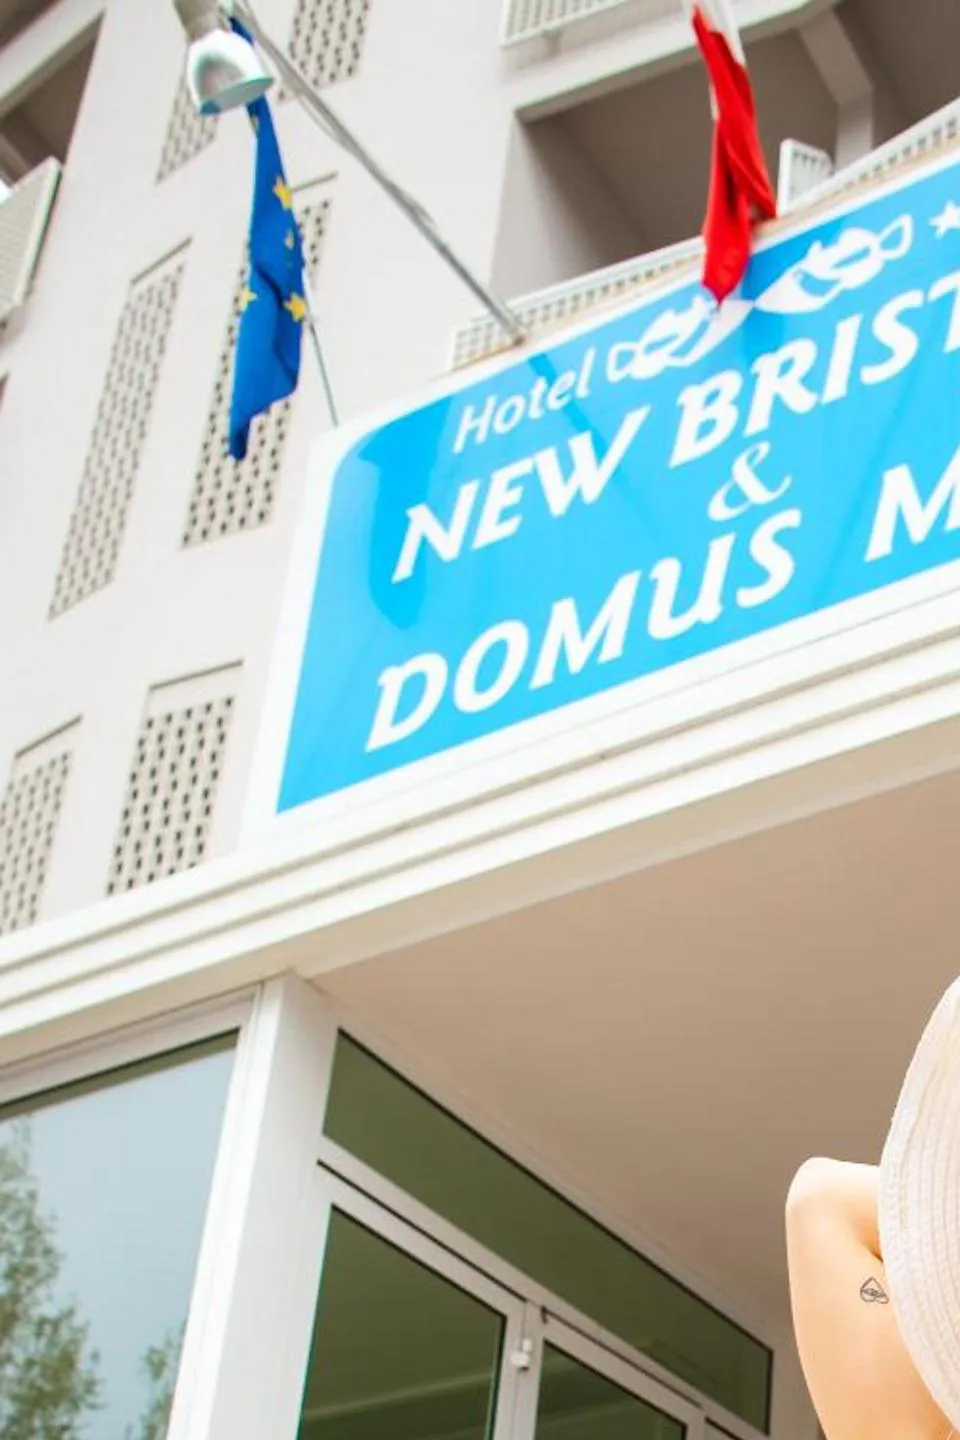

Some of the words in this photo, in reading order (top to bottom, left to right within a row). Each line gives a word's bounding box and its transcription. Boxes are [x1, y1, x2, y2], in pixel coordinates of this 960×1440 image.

[452, 344, 598, 454] Hotel
[393, 405, 651, 581] NEW
[707, 440, 793, 522] &
[366, 507, 802, 751] DOMUS
